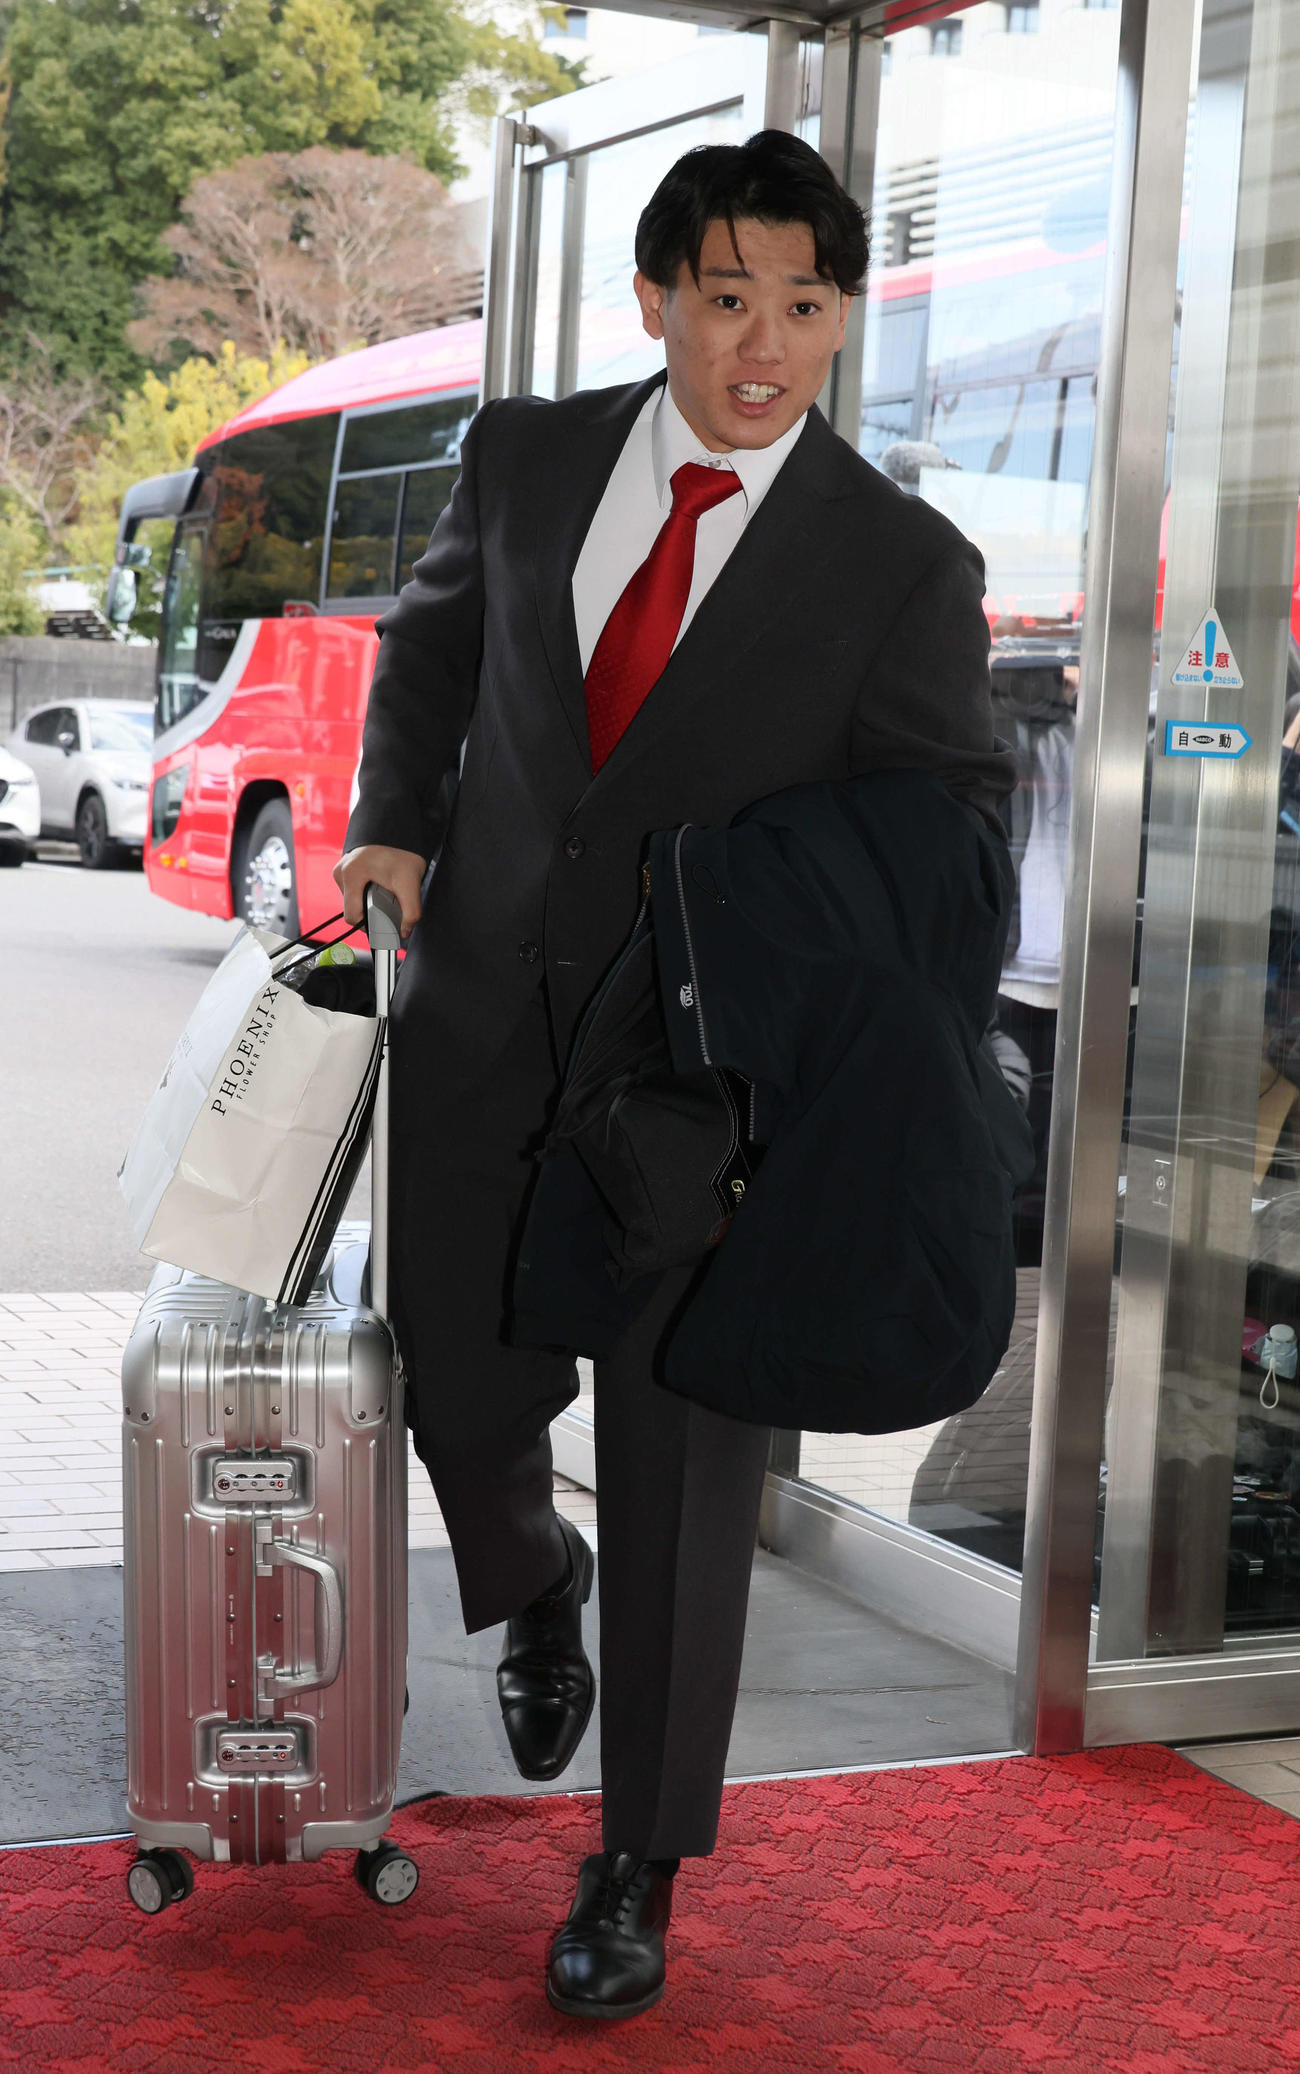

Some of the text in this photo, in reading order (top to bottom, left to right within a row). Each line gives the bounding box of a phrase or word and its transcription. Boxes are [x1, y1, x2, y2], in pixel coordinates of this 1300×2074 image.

[1188, 650, 1230, 668] 注 意
[1179, 731, 1188, 746] 自
[1219, 733, 1231, 748] 動
[211, 987, 280, 1116] PHOENIX
[236, 1014, 276, 1100] FLOWER SHOP
